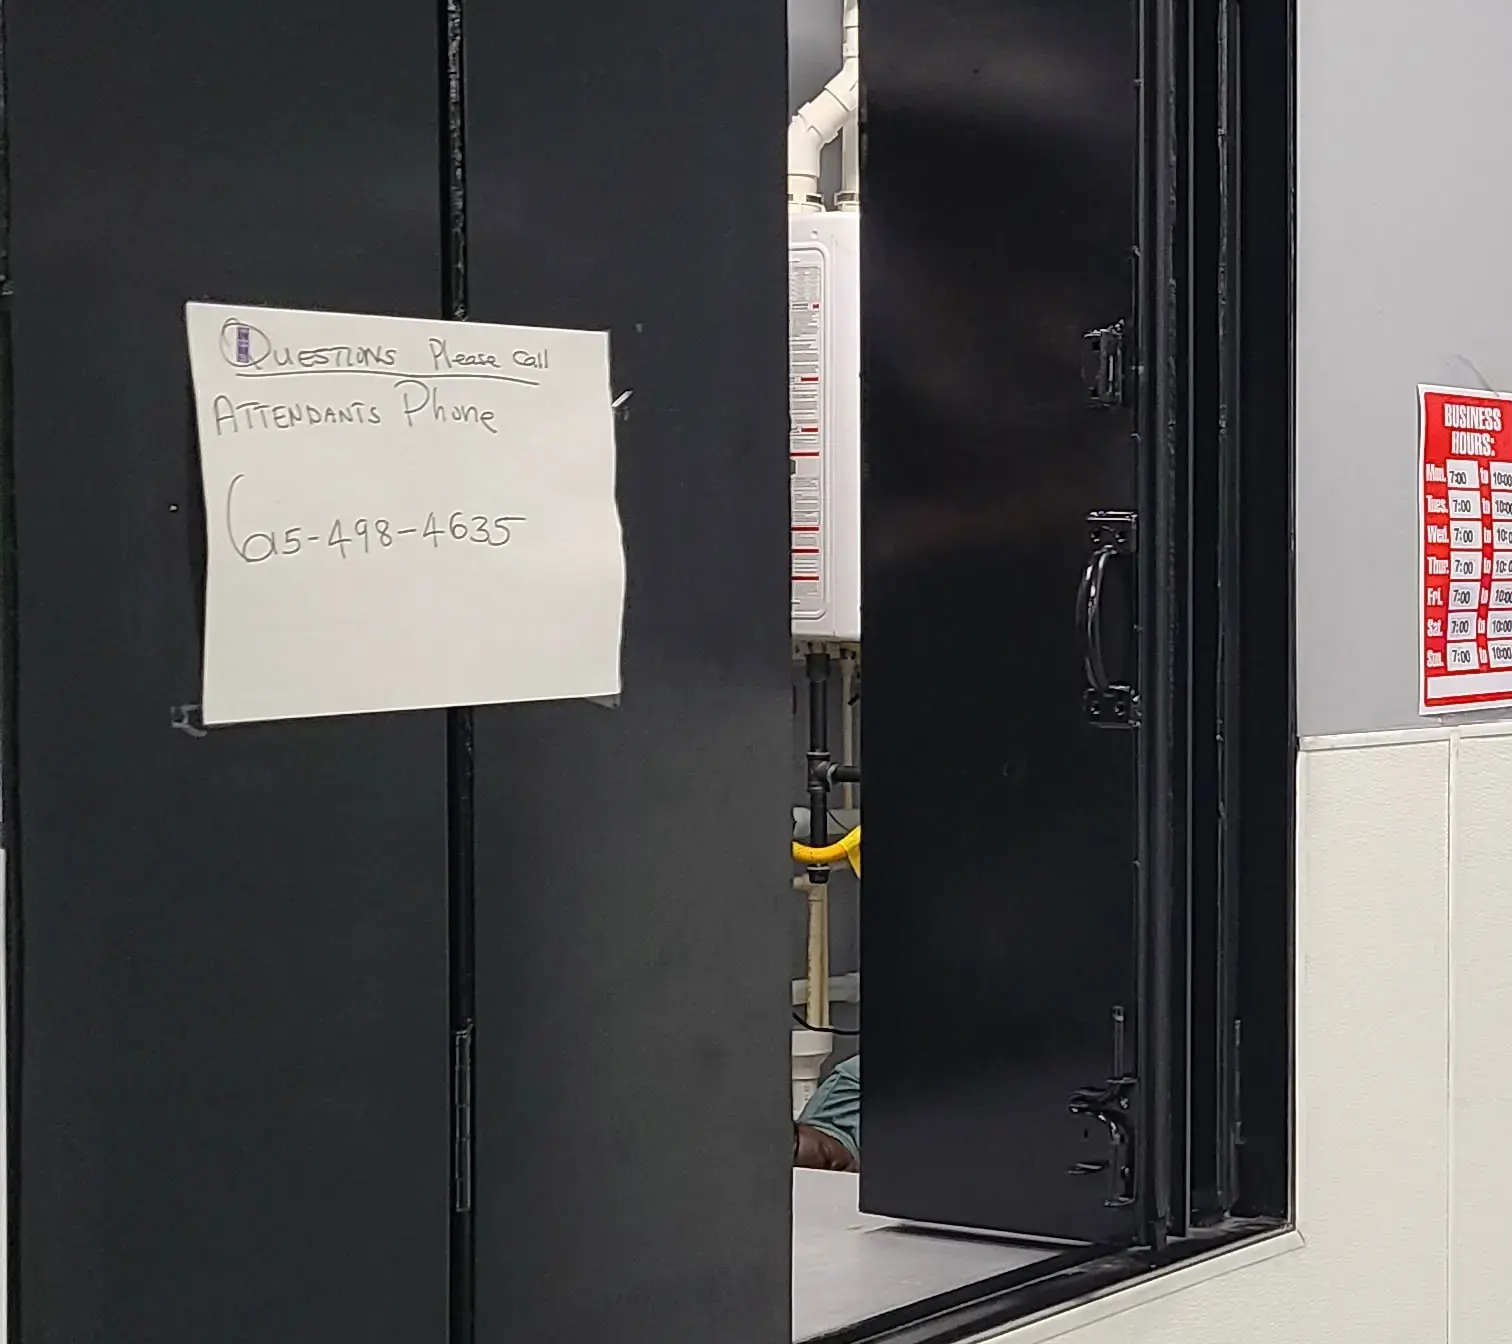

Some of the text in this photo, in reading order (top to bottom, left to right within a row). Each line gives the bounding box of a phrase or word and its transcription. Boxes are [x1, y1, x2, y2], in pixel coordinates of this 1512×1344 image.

[429, 337, 502, 371] Please
[512, 349, 549, 369] Call
[213, 379, 498, 436] ATTENDANTS Phone
[1444, 403, 1502, 431] BUSINESS
[1451, 430, 1495, 457] HOURS:
[1449, 471, 1467, 485] 7:00
[1493, 472, 1512, 487] 10:00
[1453, 499, 1471, 513] 7:00
[227, 473, 527, 564] 615-498-4635
[1453, 527, 1473, 543] 7:00
[1454, 559, 1473, 575] 7:00
[1453, 589, 1470, 604] 7:00
[1451, 620, 1469, 633] 7:00
[1492, 620, 1512, 633] 10:00
[1452, 649, 1470, 663] 7:00
[1492, 647, 1512, 660] 10:00
